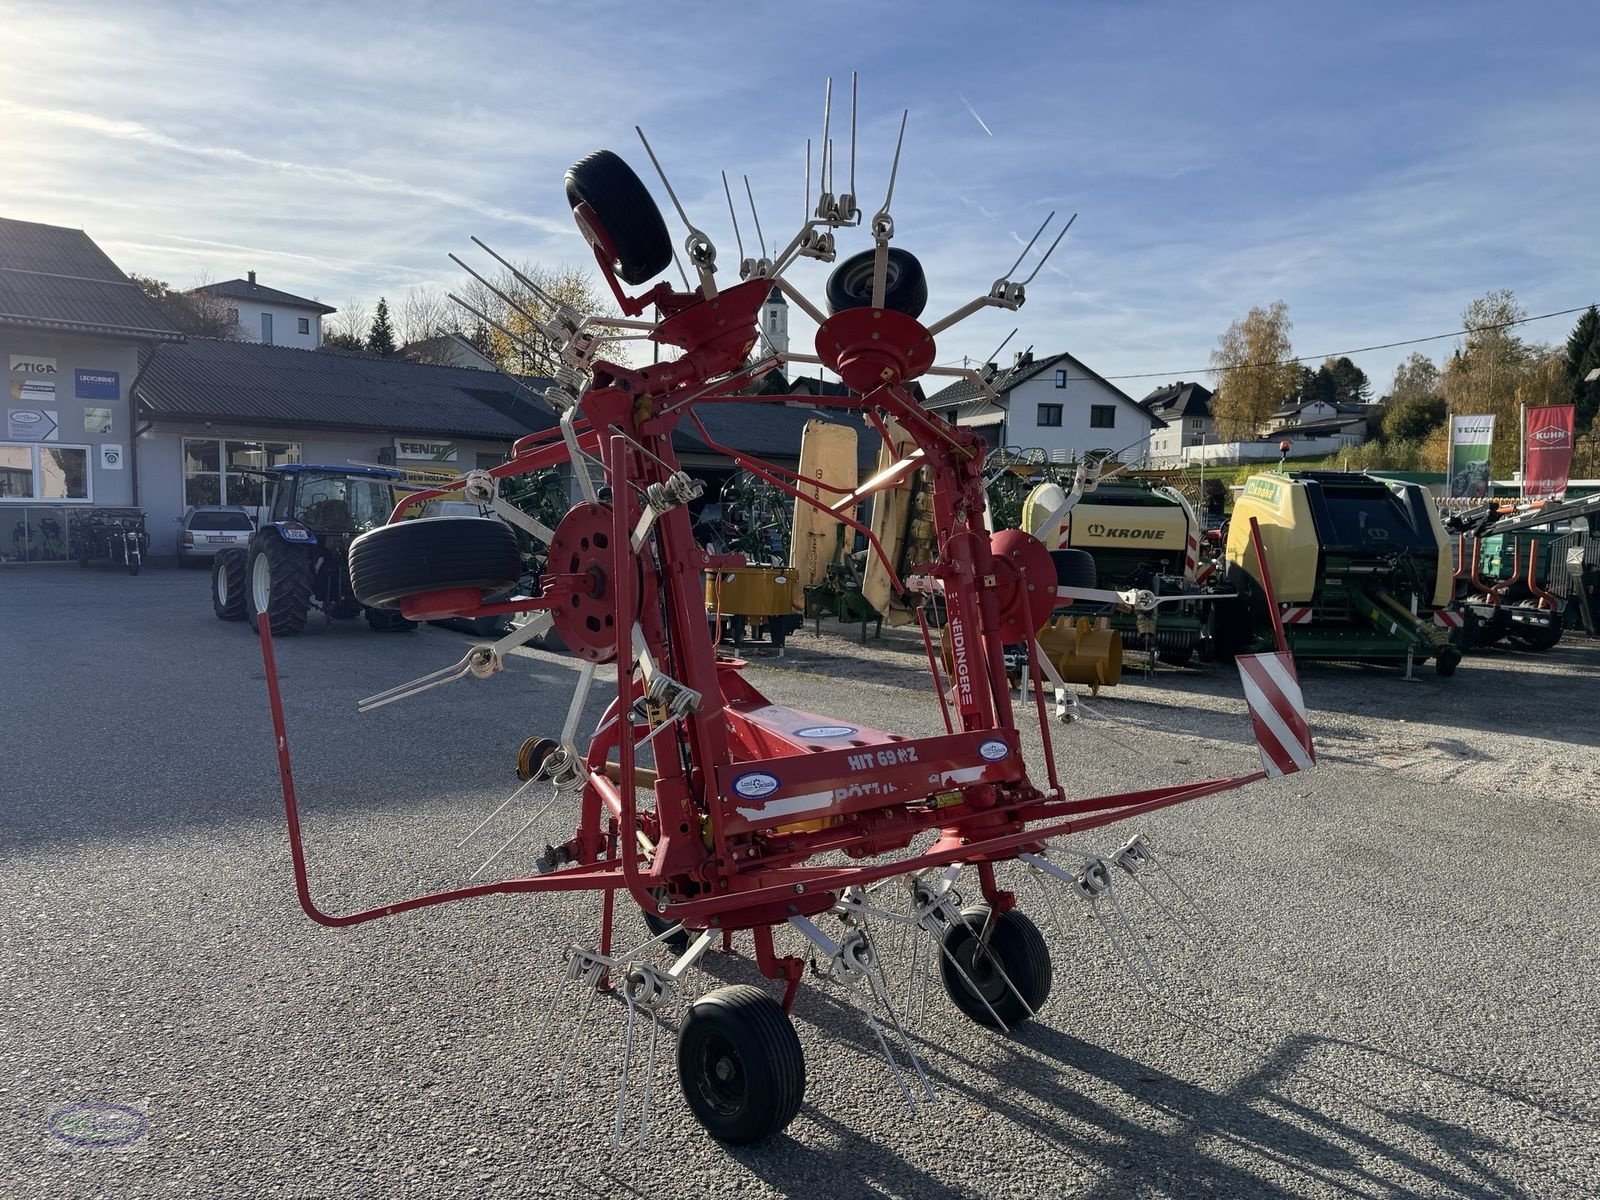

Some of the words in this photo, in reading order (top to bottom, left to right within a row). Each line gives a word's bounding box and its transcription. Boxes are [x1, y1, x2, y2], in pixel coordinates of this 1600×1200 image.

[13, 362, 57, 373] STIGA
[1457, 426, 1491, 434] FENDT
[1536, 431, 1565, 439] KUHN
[1255, 486, 1275, 499] KRONE
[1106, 528, 1166, 540] KRONE
[847, 753, 874, 771] HIT
